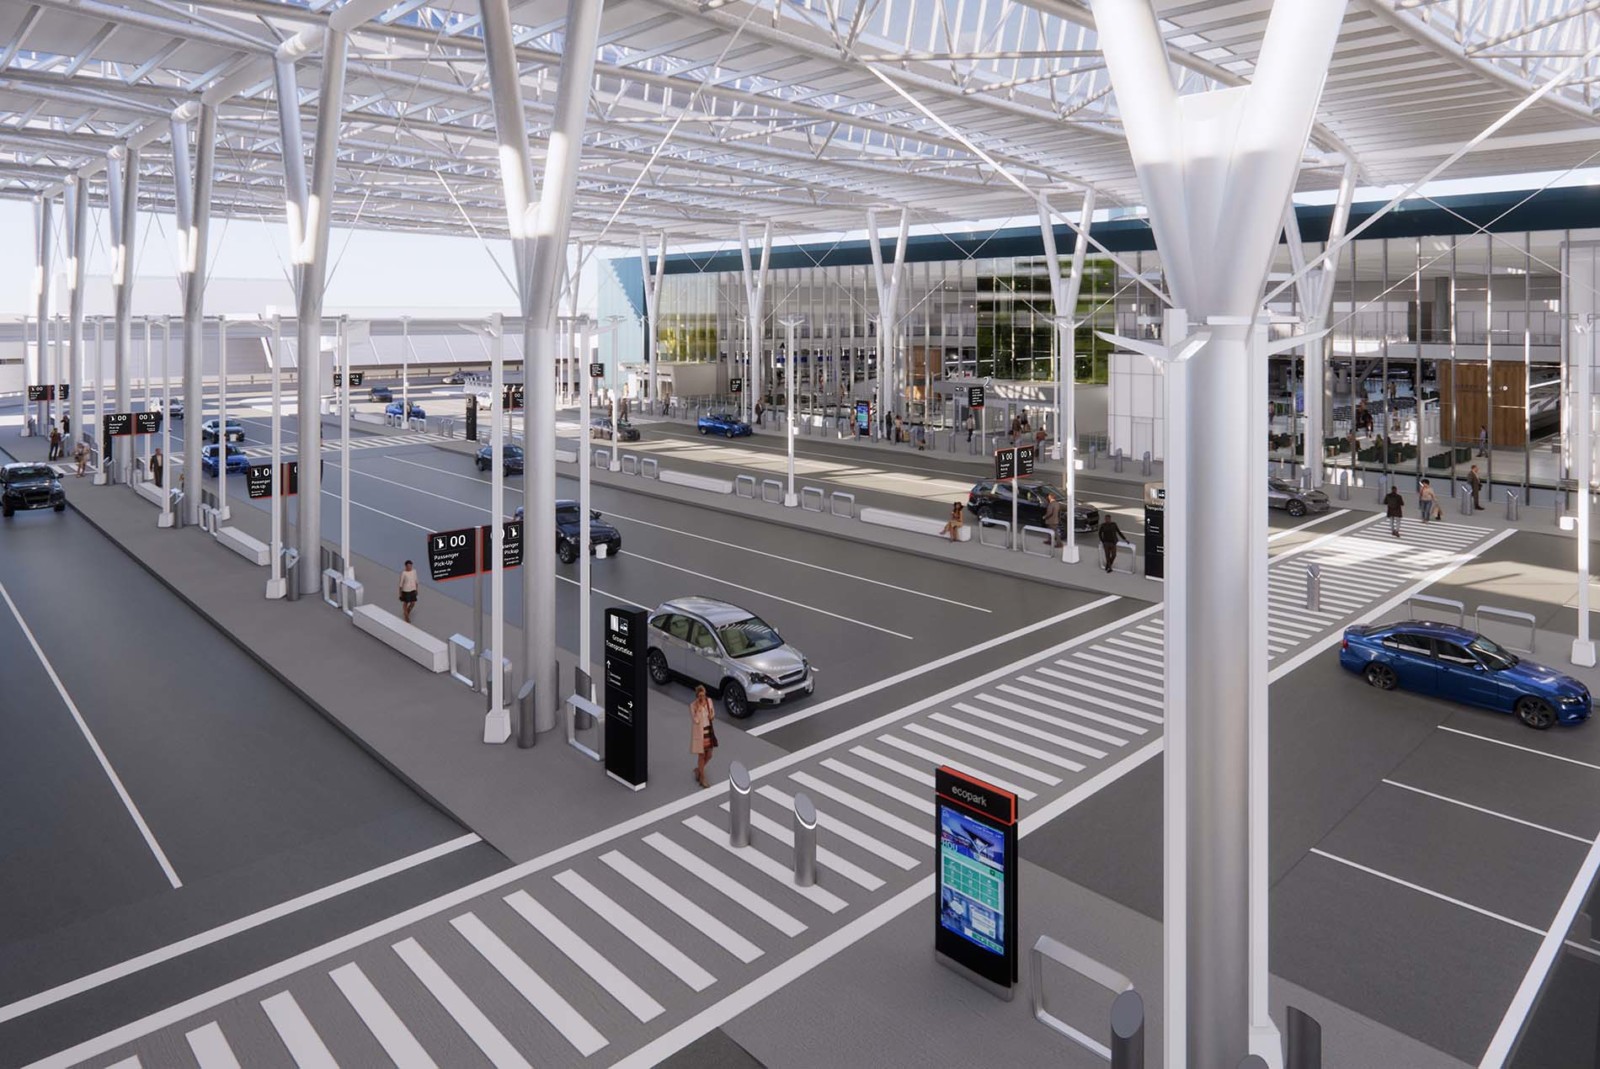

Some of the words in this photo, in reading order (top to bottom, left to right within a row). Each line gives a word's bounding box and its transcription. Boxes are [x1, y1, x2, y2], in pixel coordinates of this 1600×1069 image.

[1005, 452, 1013, 461] 00
[1020, 450, 1028, 458] 00
[450, 535, 467, 548] 00
[434, 552, 460, 561] Passenger
[434, 560, 454, 568] Pick-Up
[611, 633, 627, 645] Ground
[951, 786, 988, 807] ecopark
